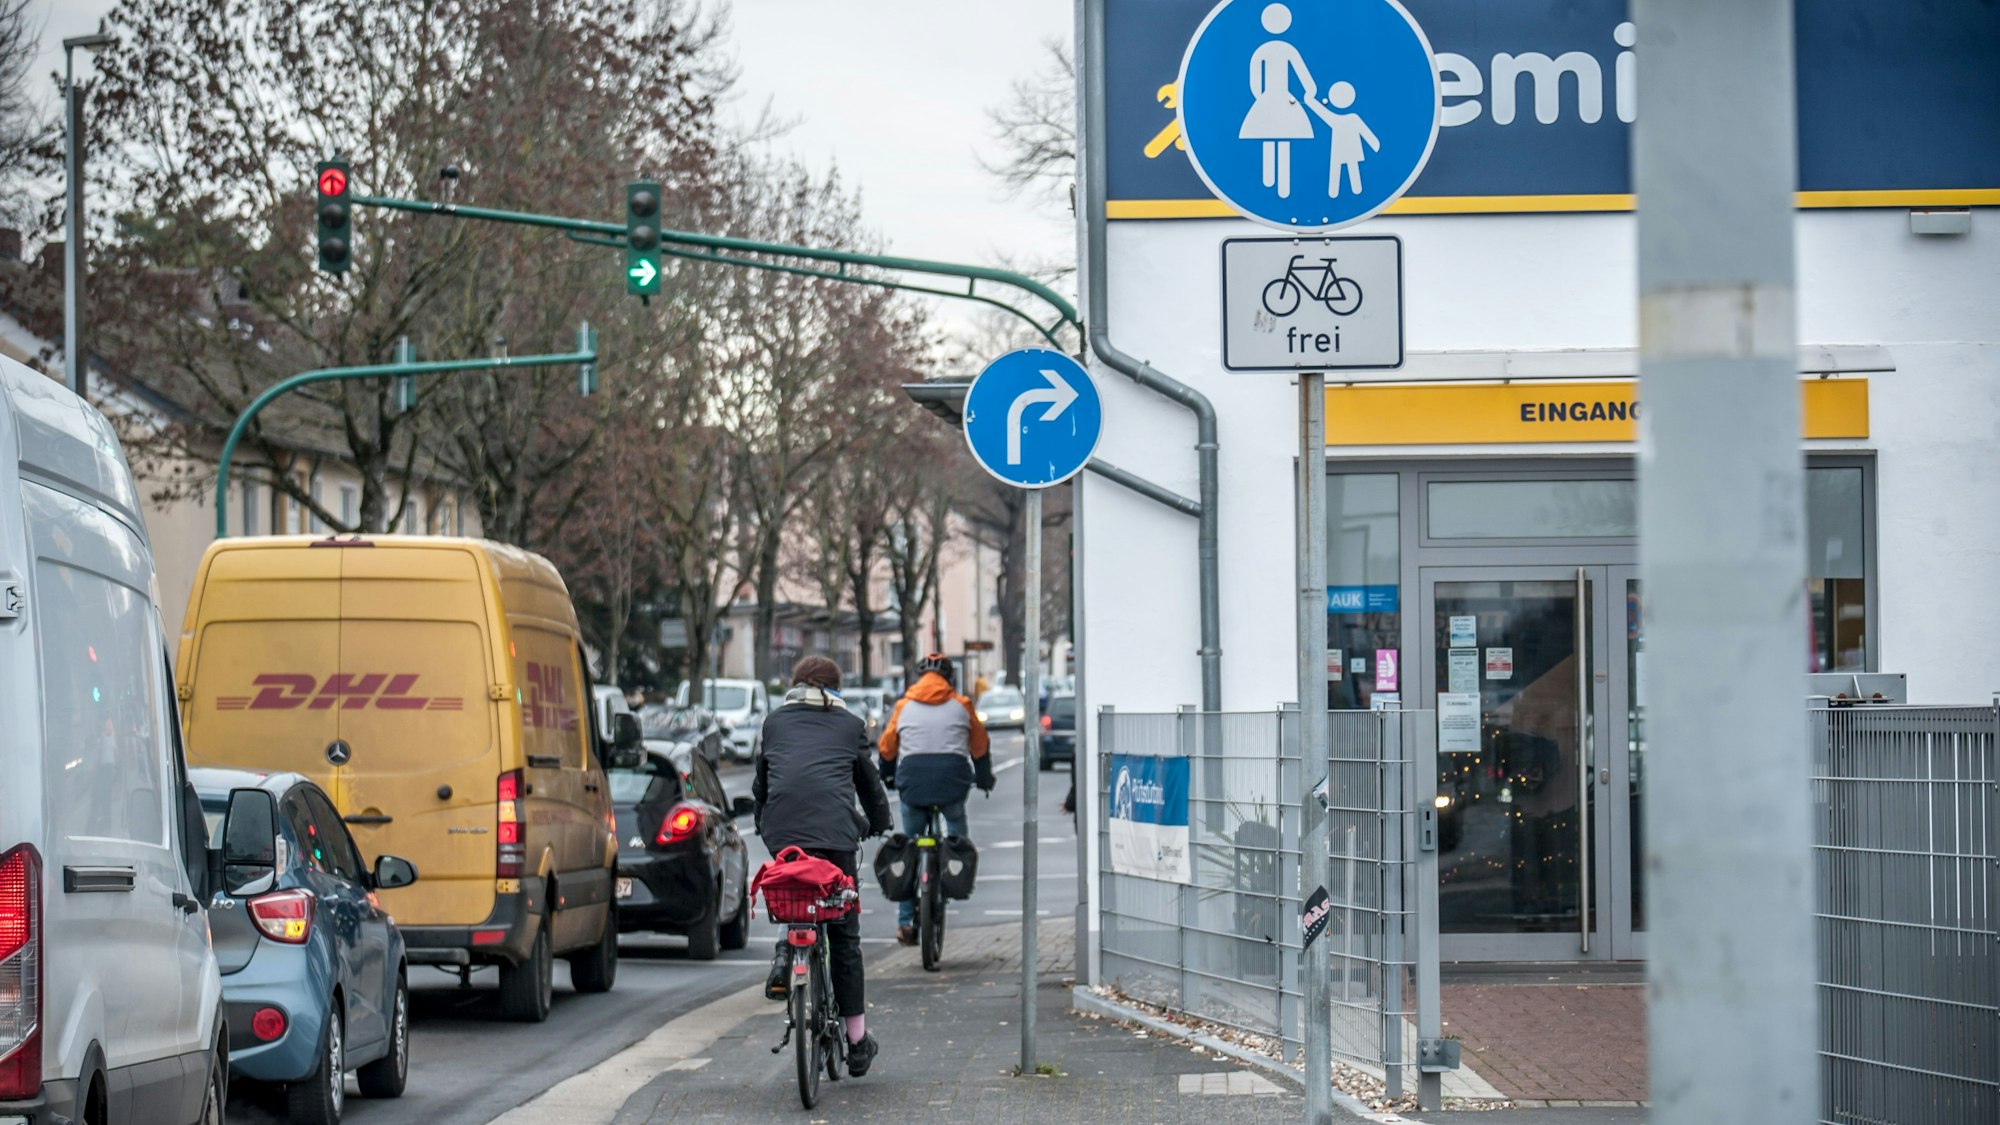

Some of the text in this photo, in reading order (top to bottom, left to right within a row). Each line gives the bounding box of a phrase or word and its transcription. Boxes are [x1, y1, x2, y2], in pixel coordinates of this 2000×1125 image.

[1286, 325, 1340, 353] frei
[249, 673, 430, 710] DHL
[526, 660, 572, 731] DHL
